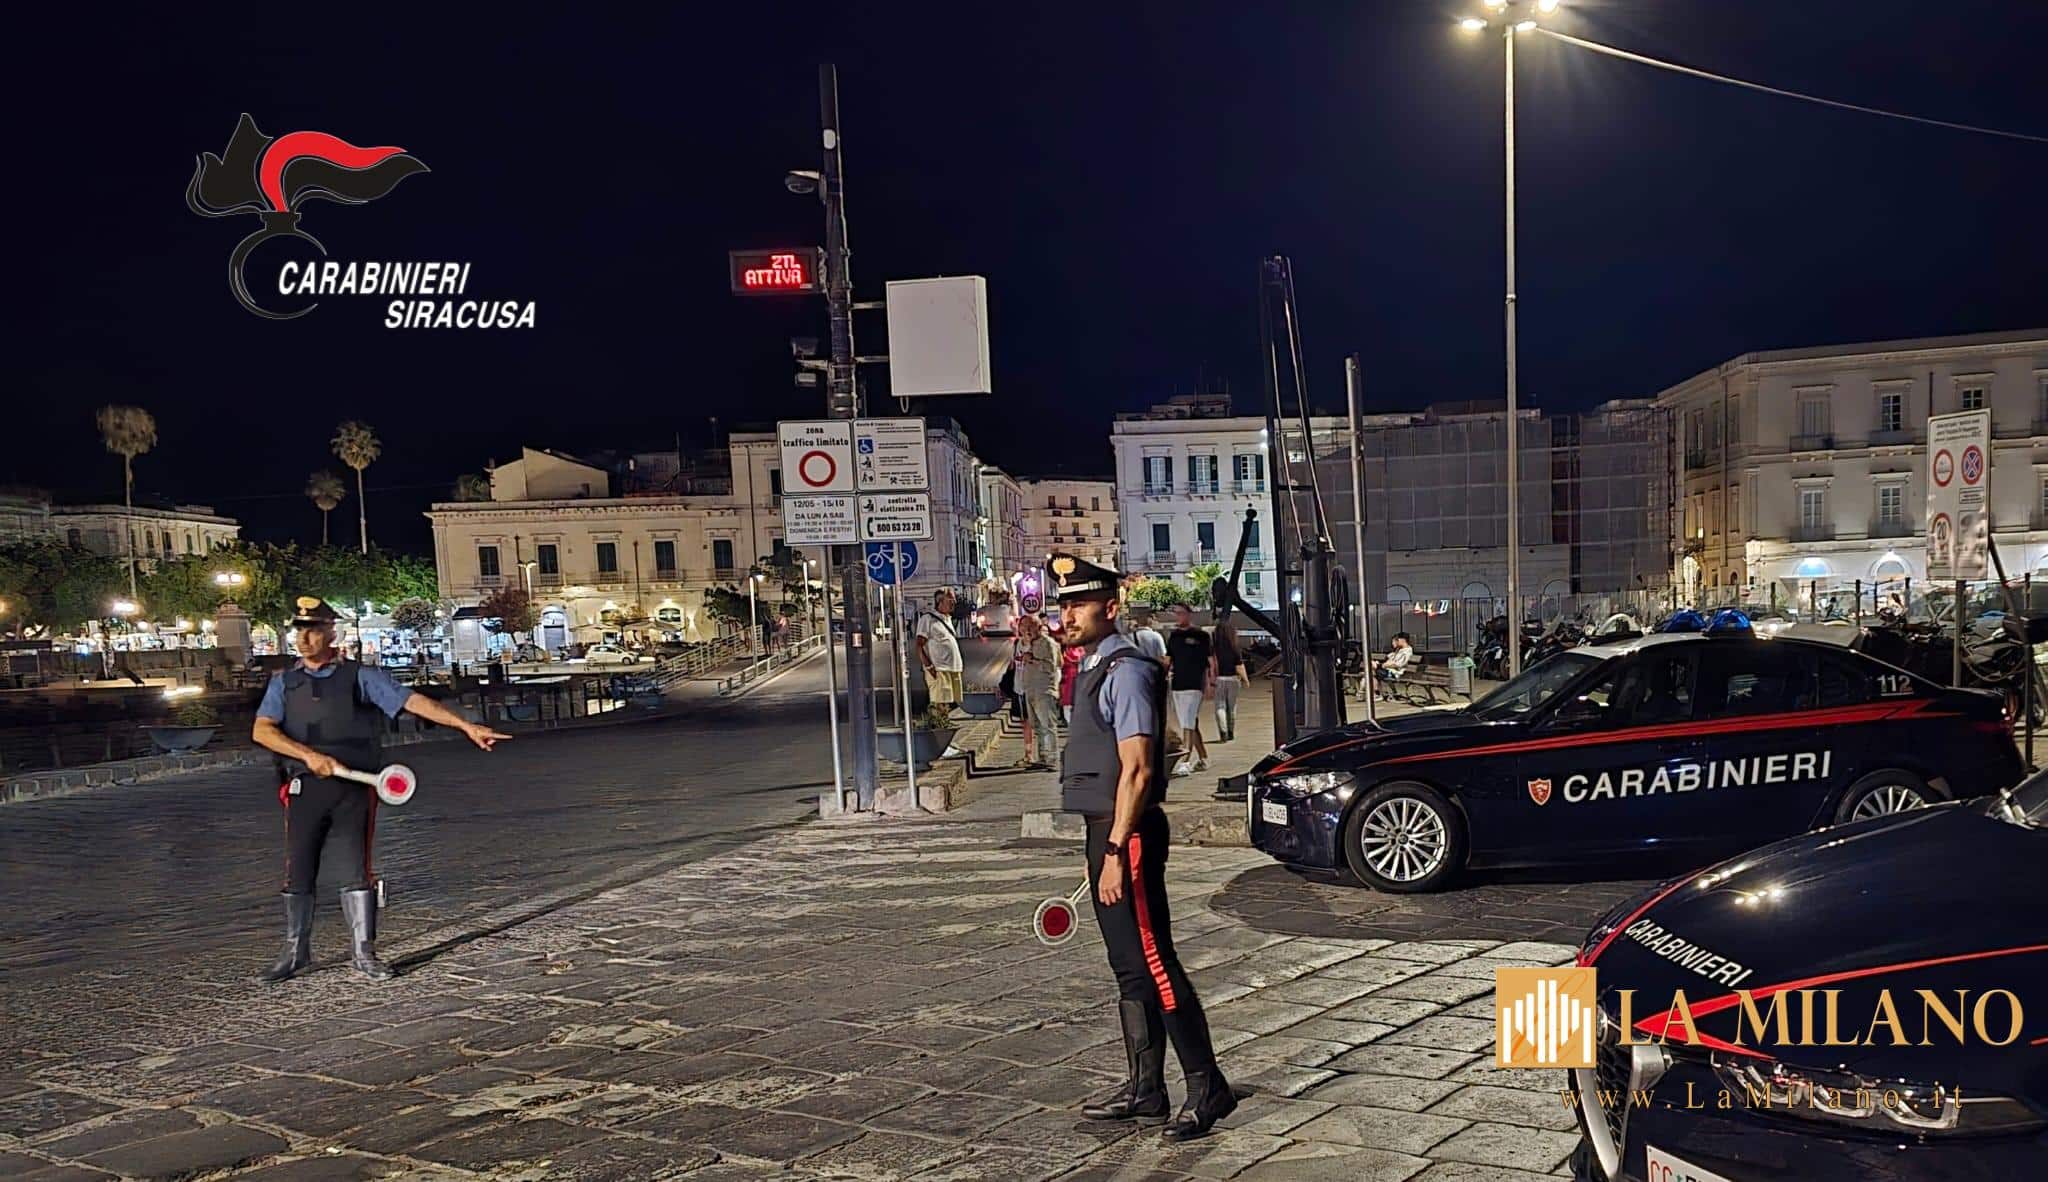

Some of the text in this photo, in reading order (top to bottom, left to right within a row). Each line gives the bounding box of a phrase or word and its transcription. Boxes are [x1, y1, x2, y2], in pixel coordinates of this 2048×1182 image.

[771, 255, 801, 269] ZTL
[745, 269, 802, 285] ATTIVA
[783, 437, 849, 447] traffico limitato
[793, 500, 815, 508] 12/05
[1025, 599, 1037, 608] 30
[1877, 674, 1913, 693] 112
[1563, 750, 1831, 803] CARABINIERI
[1625, 918, 1753, 987] CARABINIERI
